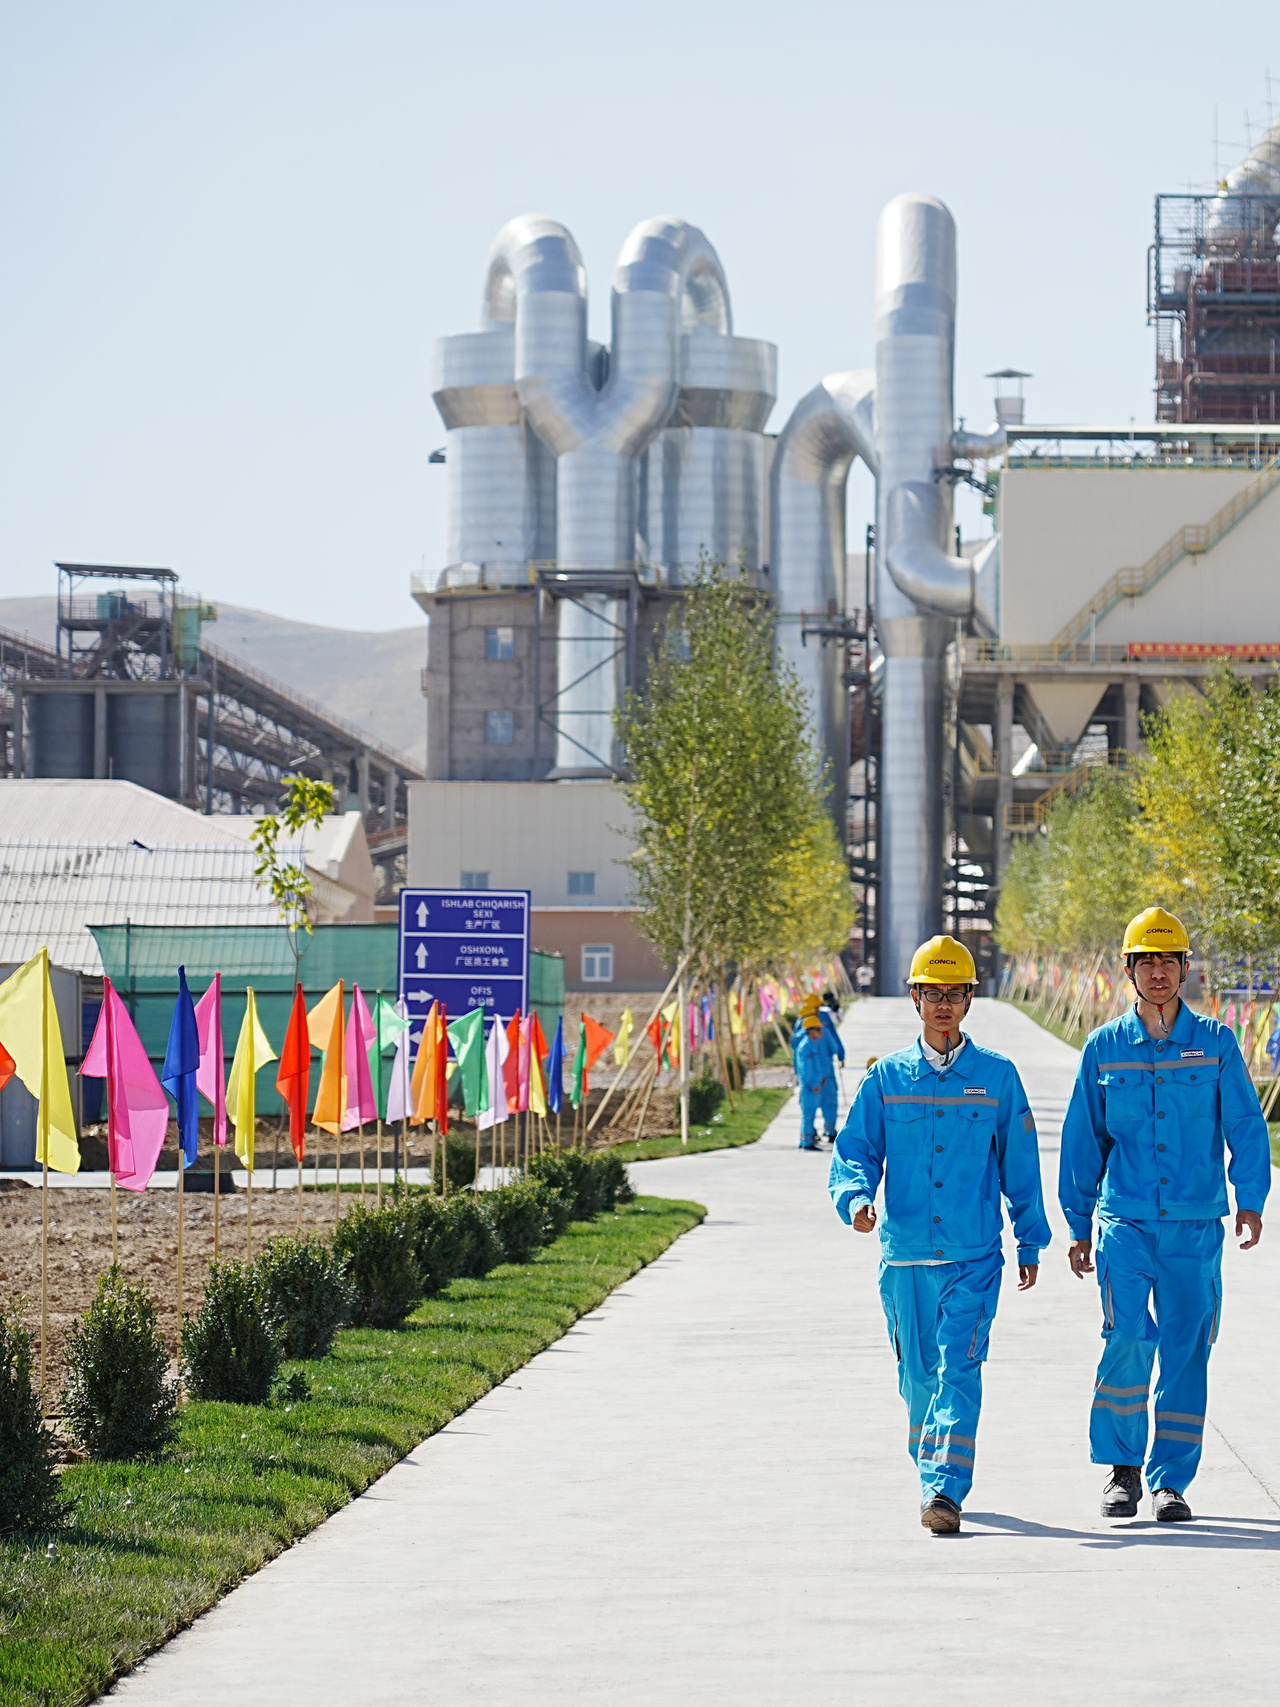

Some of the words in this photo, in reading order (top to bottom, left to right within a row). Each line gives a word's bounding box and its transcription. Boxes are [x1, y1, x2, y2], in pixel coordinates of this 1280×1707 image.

[442, 899, 474, 908] ISHLAB
[475, 899, 524, 909] CHIQARISH
[473, 910, 493, 918] SEXI
[465, 920, 501, 930] 生产厂区
[460, 946, 504, 955] OSHXONA
[455, 957, 509, 967] 厂区员工食堂
[470, 986, 492, 995] OFIS
